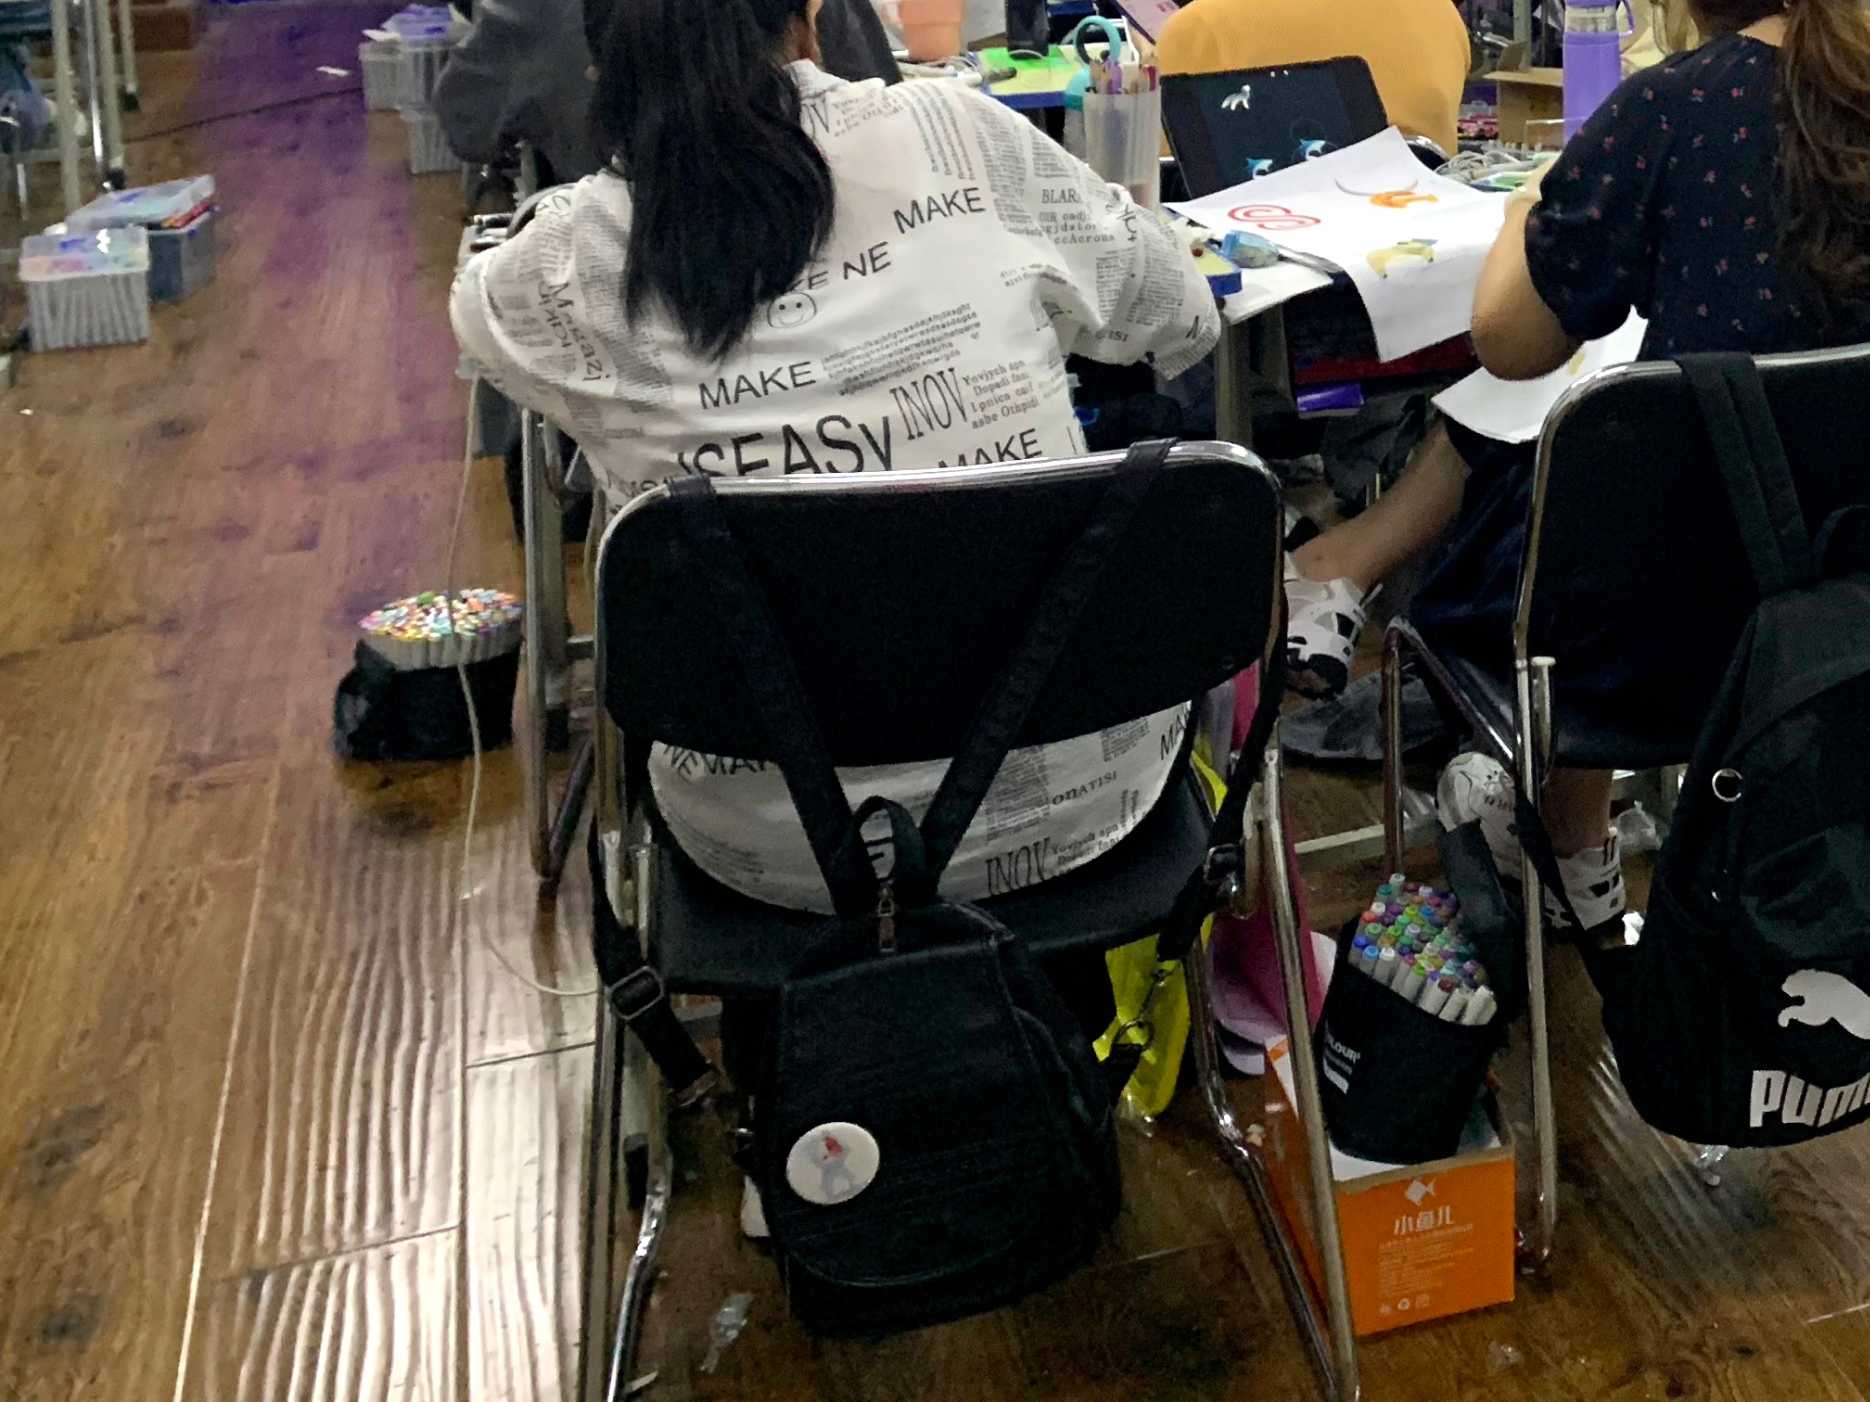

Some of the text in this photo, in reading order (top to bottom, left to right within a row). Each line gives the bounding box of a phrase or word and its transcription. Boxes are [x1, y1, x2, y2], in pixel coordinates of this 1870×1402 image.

[893, 186, 986, 234] MAKE
[698, 361, 817, 410] MAKE
[889, 367, 968, 441] INOV
